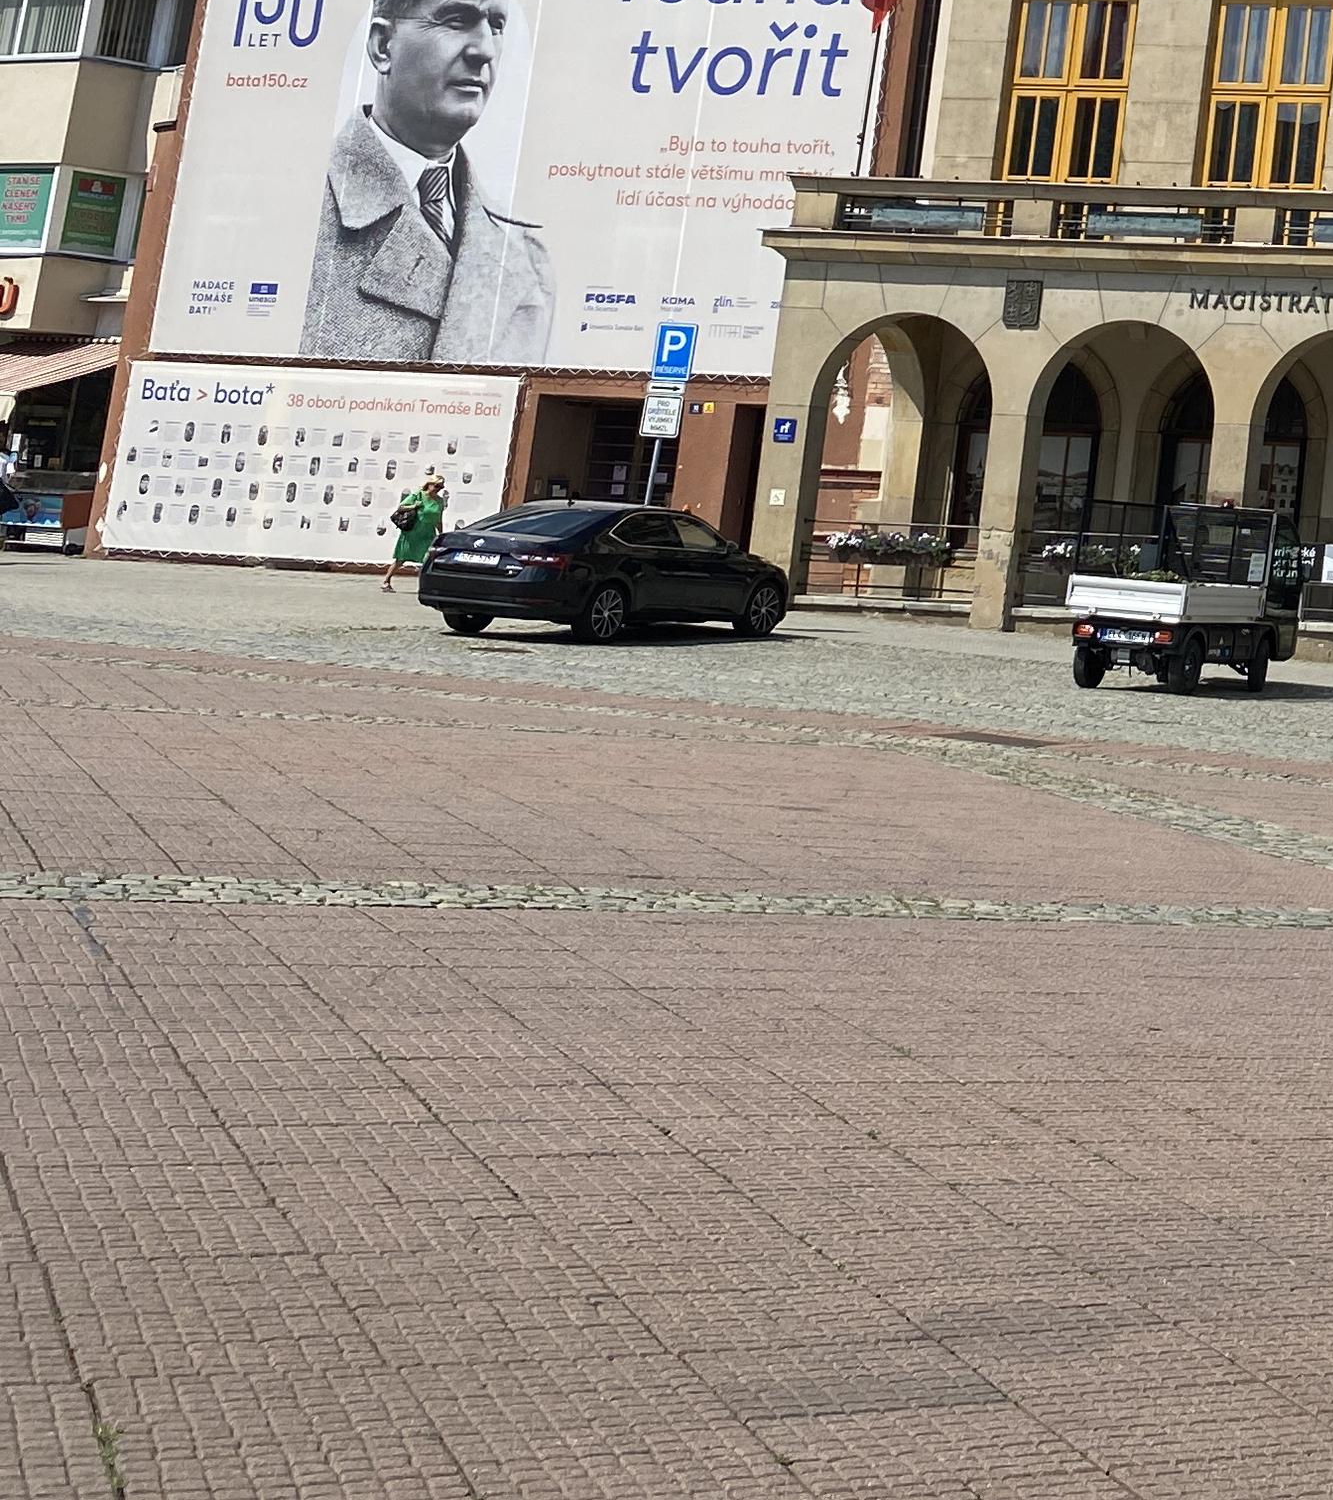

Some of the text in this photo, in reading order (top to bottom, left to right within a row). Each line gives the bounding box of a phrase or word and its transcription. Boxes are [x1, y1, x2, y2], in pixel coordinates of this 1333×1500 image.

[248, 33, 282, 47] LET
[630, 21, 849, 97] tvořit
[226, 73, 308, 88] bata150.cz
[711, 139, 727, 153] to
[733, 138, 781, 154] touha
[787, 138, 835, 157] tvořit,
[548, 162, 641, 181] poskytnout
[646, 161, 686, 180] stále
[691, 162, 754, 181] většímu
[616, 190, 795, 213] lidí účast na výhodác
[192, 280, 235, 290] NADACE
[191, 292, 233, 303] TOMÁŠE
[585, 293, 636, 304] FOSFA
[661, 296, 696, 305] KOMA
[661, 330, 688, 363] P
[141, 378, 191, 402] Baťa
[286, 393, 502, 417] 38 oborů podnikání Tomáše Bati
